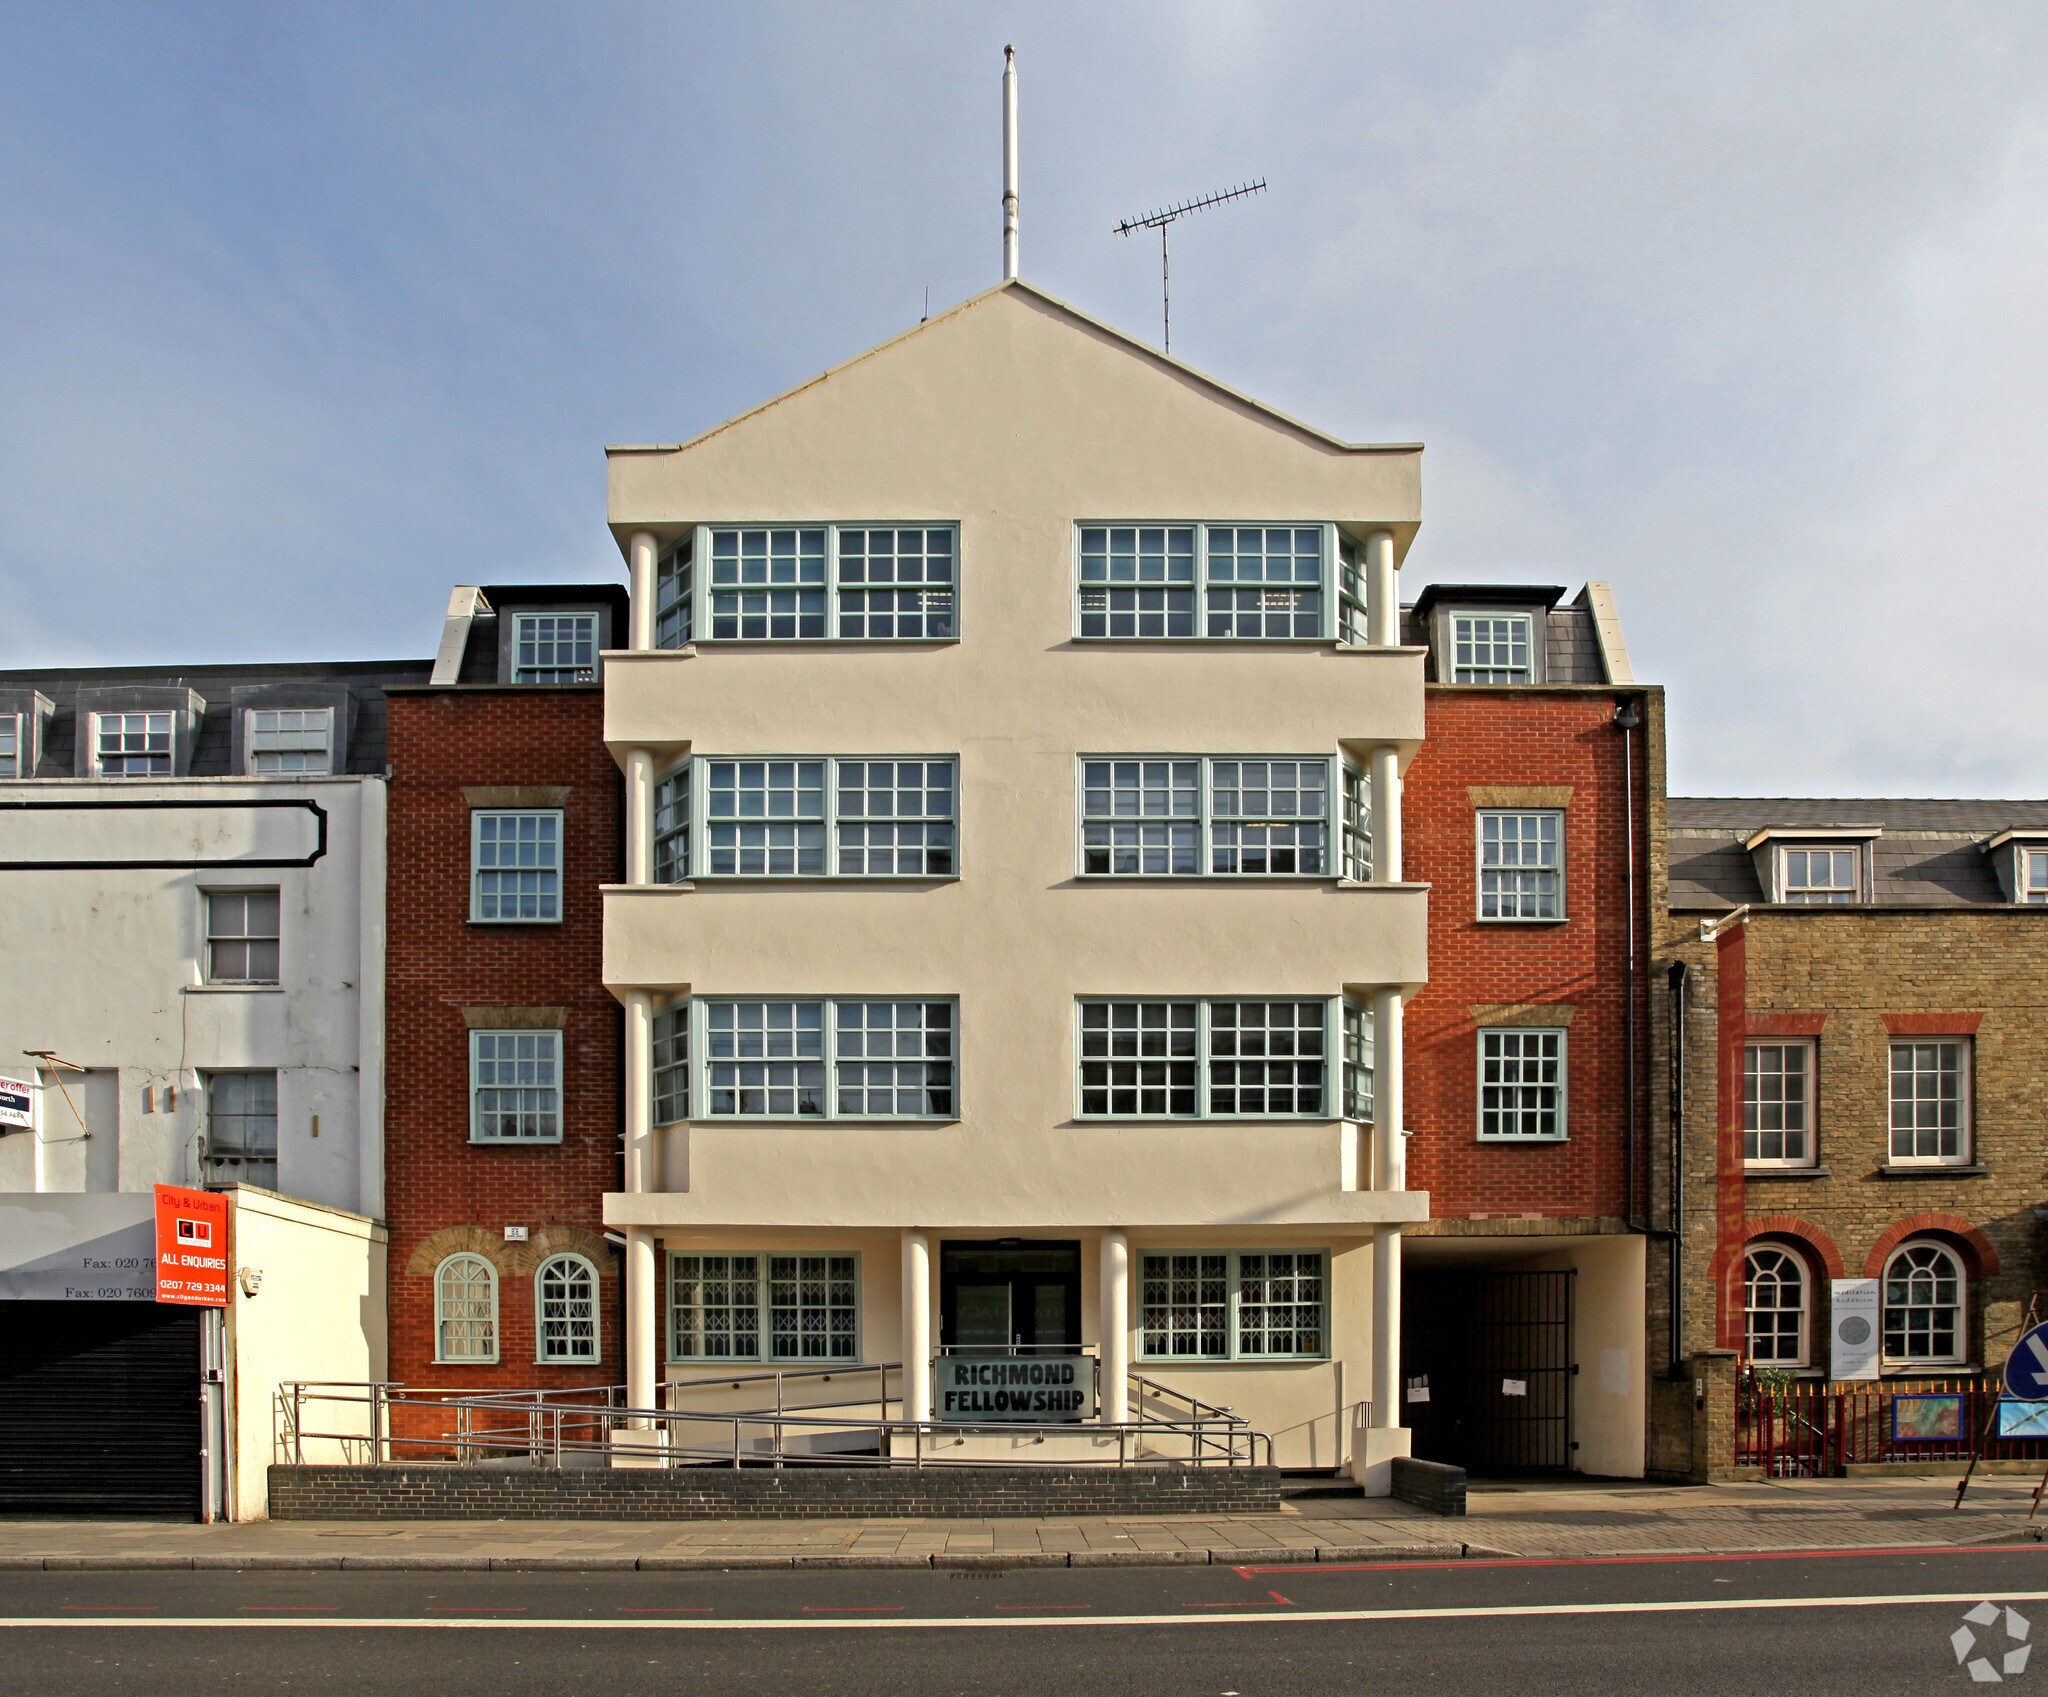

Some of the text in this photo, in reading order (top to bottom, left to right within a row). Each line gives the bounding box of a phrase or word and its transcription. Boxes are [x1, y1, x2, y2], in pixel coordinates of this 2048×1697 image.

[10, 1083, 30, 1095] offer
[162, 1194, 180, 1208] City
[183, 1198, 190, 1208] &
[83, 1258, 111, 1269] Fax:
[115, 1258, 138, 1268] 020
[161, 1253, 226, 1270] ALL ENQUIRIES
[65, 1288, 157, 1298] Fax: 020 7609
[160, 1280, 226, 1293] 0207 729 3344
[955, 1364, 1074, 1385] RICHMOND
[944, 1390, 1085, 1411] FELLOWSHIP
